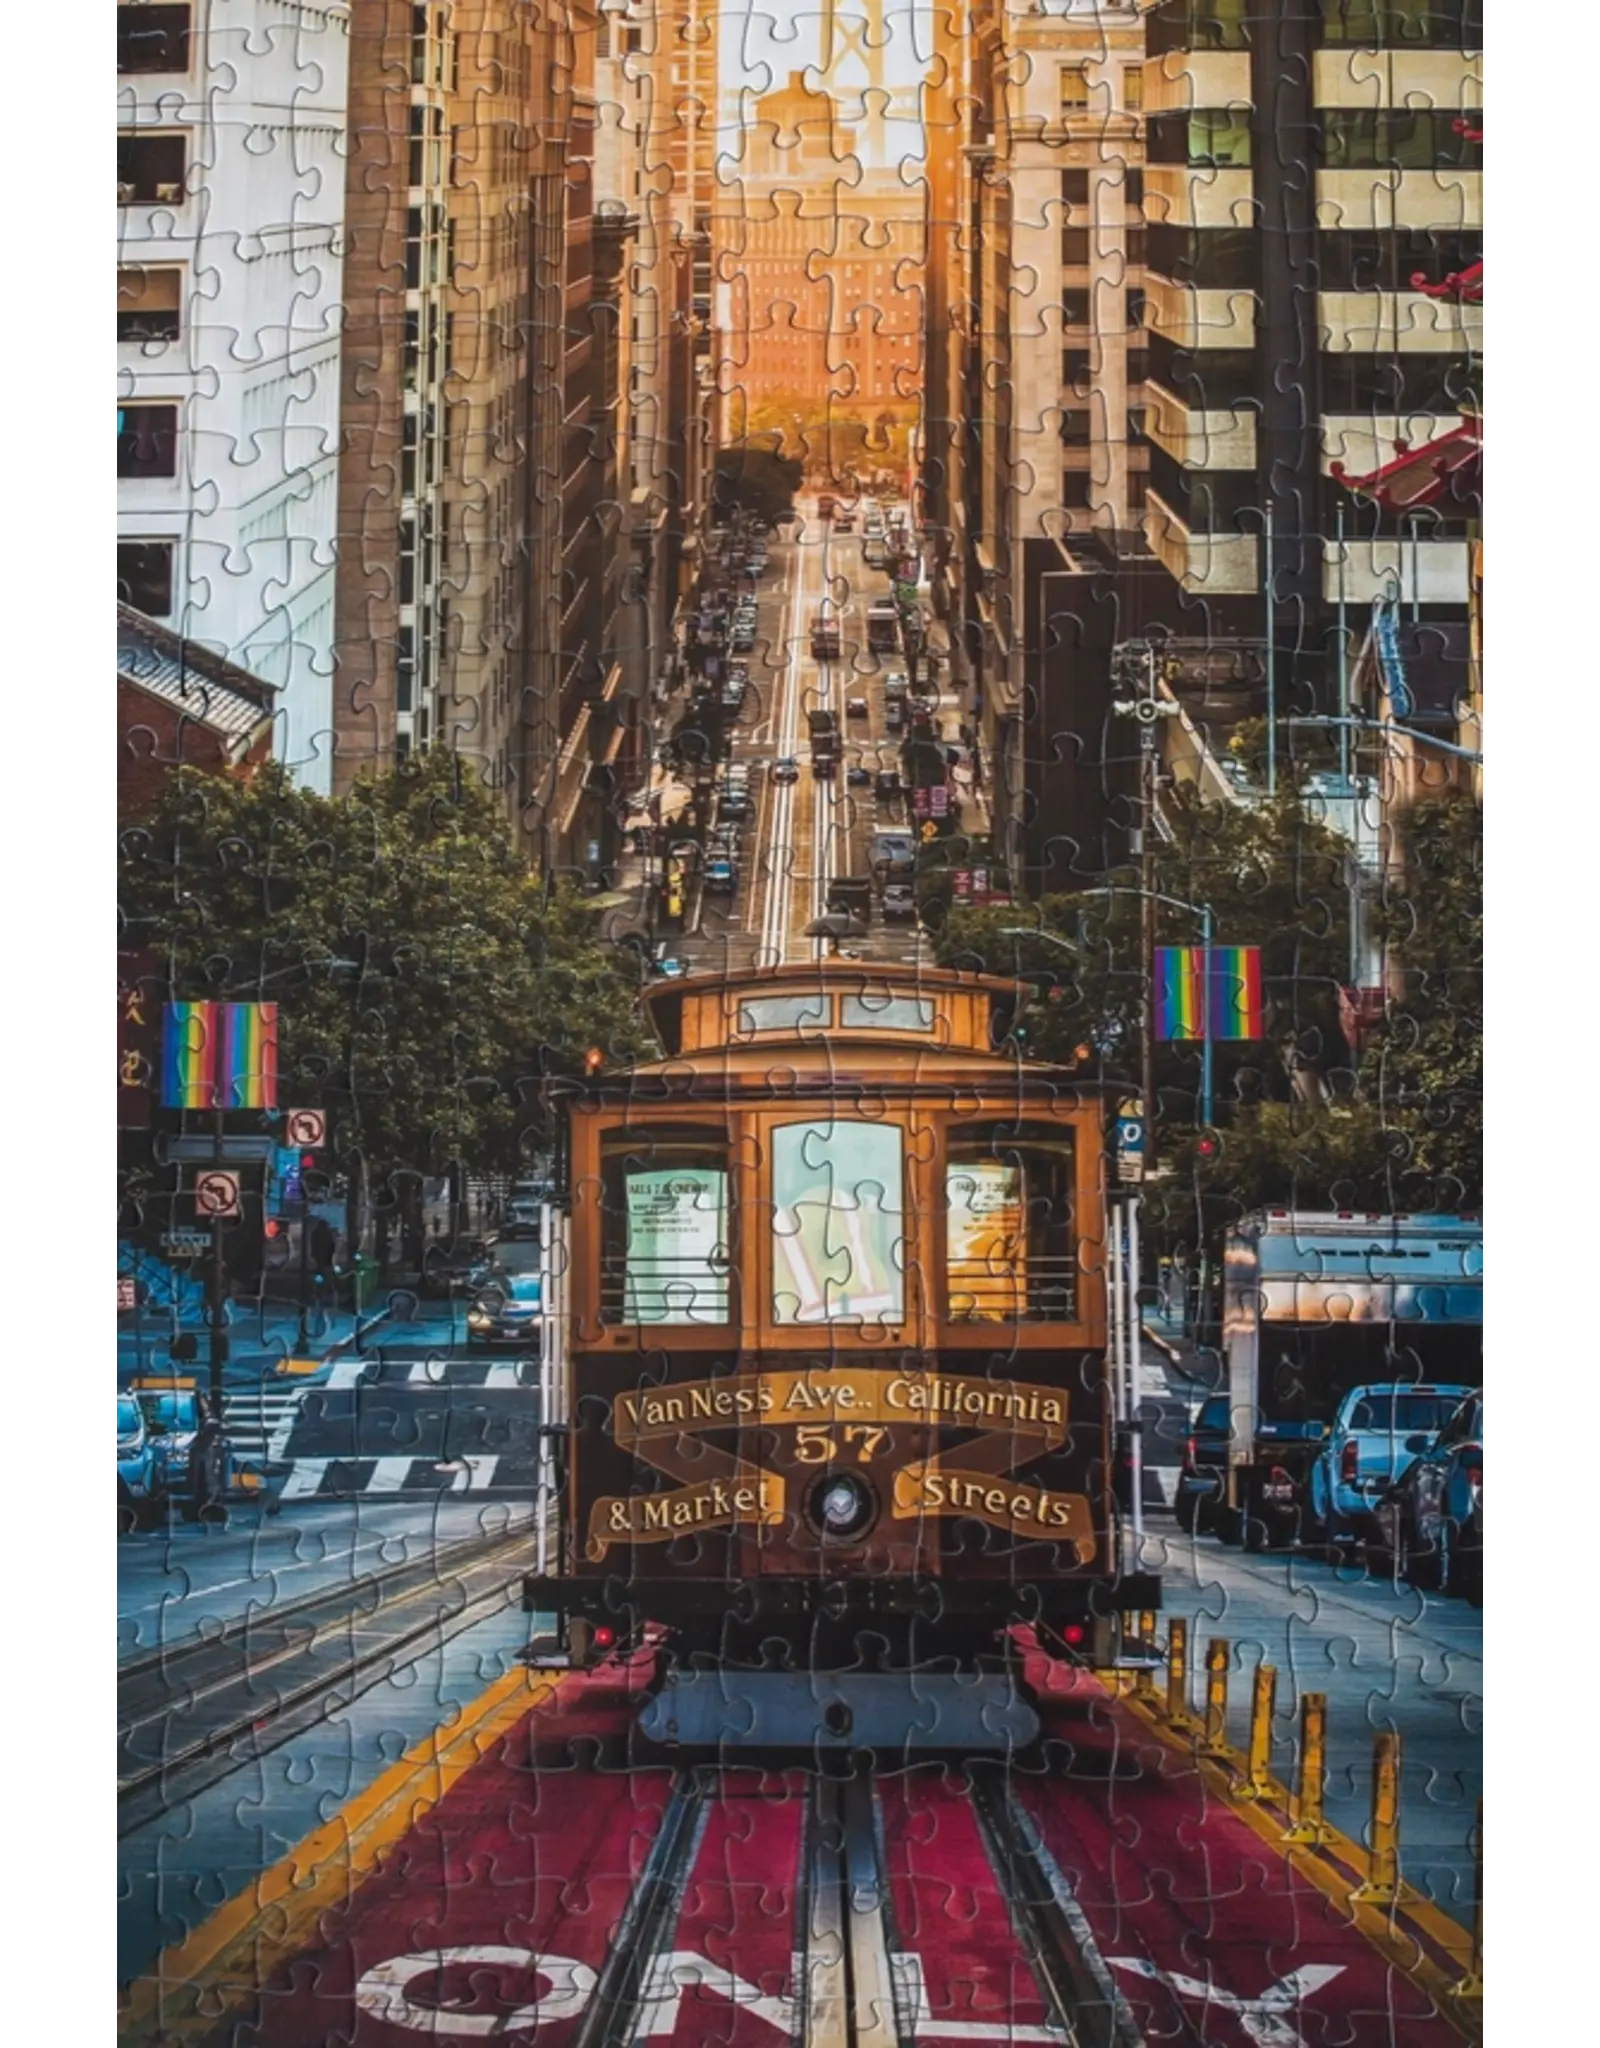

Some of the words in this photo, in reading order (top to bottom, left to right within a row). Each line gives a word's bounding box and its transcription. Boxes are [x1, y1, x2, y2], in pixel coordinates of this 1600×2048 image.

[624, 1397, 684, 1425] Van
[690, 1387, 773, 1418] Ness
[886, 1378, 1061, 1423] California
[795, 1424, 886, 1463] 57
[609, 1500, 631, 1530] &
[644, 1480, 769, 1529] Market
[924, 1475, 1072, 1525] Streets
[355, 1944, 1348, 2048] ONLY
